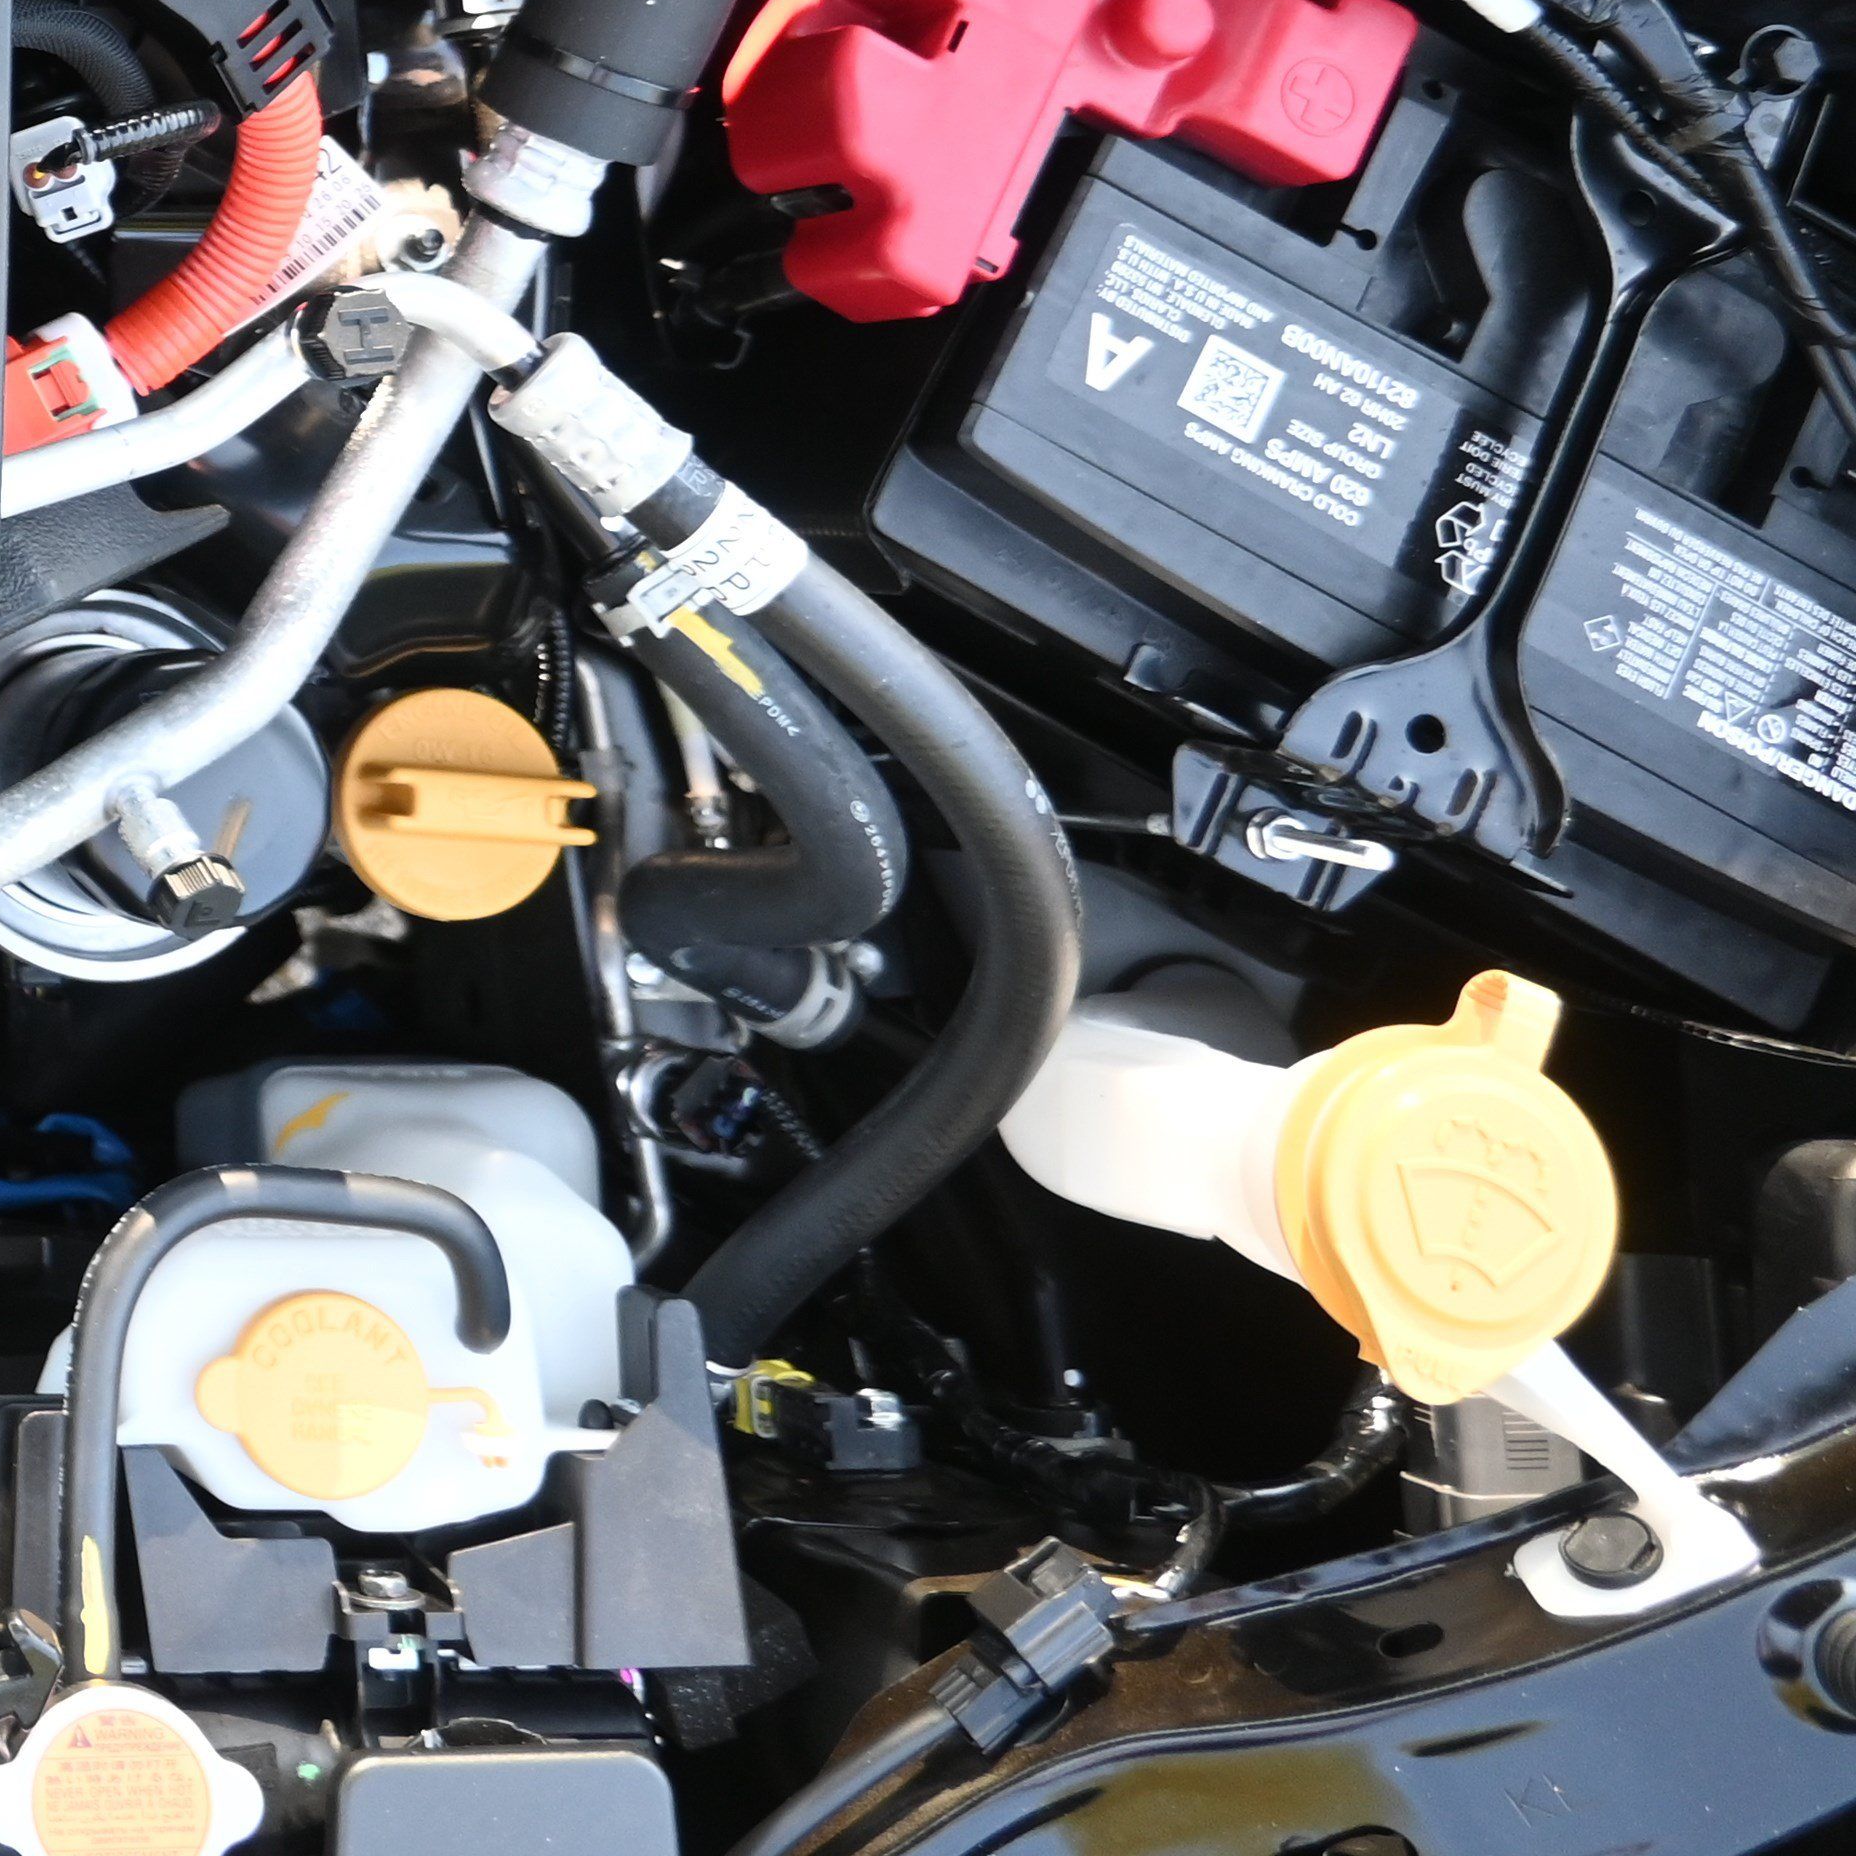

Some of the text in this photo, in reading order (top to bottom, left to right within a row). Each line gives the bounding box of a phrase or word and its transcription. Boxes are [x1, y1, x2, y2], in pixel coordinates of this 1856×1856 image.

[1120, 232, 1275, 325] AND IMPORTED MATERIALS
[1135, 258, 1171, 284] WITH
[1113, 293, 1192, 344] DISTRIBUTED
[1216, 300, 1255, 329] MADE
[1061, 308, 1158, 405] A
[1277, 320, 1423, 411] 82110AN00B
[1311, 370, 1408, 431] 20HR 62 AH
[1284, 416, 1384, 480] GROUP SIZE
[1345, 419, 1396, 459] LN2
[1458, 439, 1491, 463] DOIT
[1180, 418, 1363, 528] COLD CRANKING AMPS
[1260, 434, 1373, 507] 620 AMPS
[1454, 471, 1490, 497] MUST
[1458, 534, 1494, 565] Pb
[252, 1305, 407, 1368] COOLANT
[94, 1727, 165, 1740] WARNING
